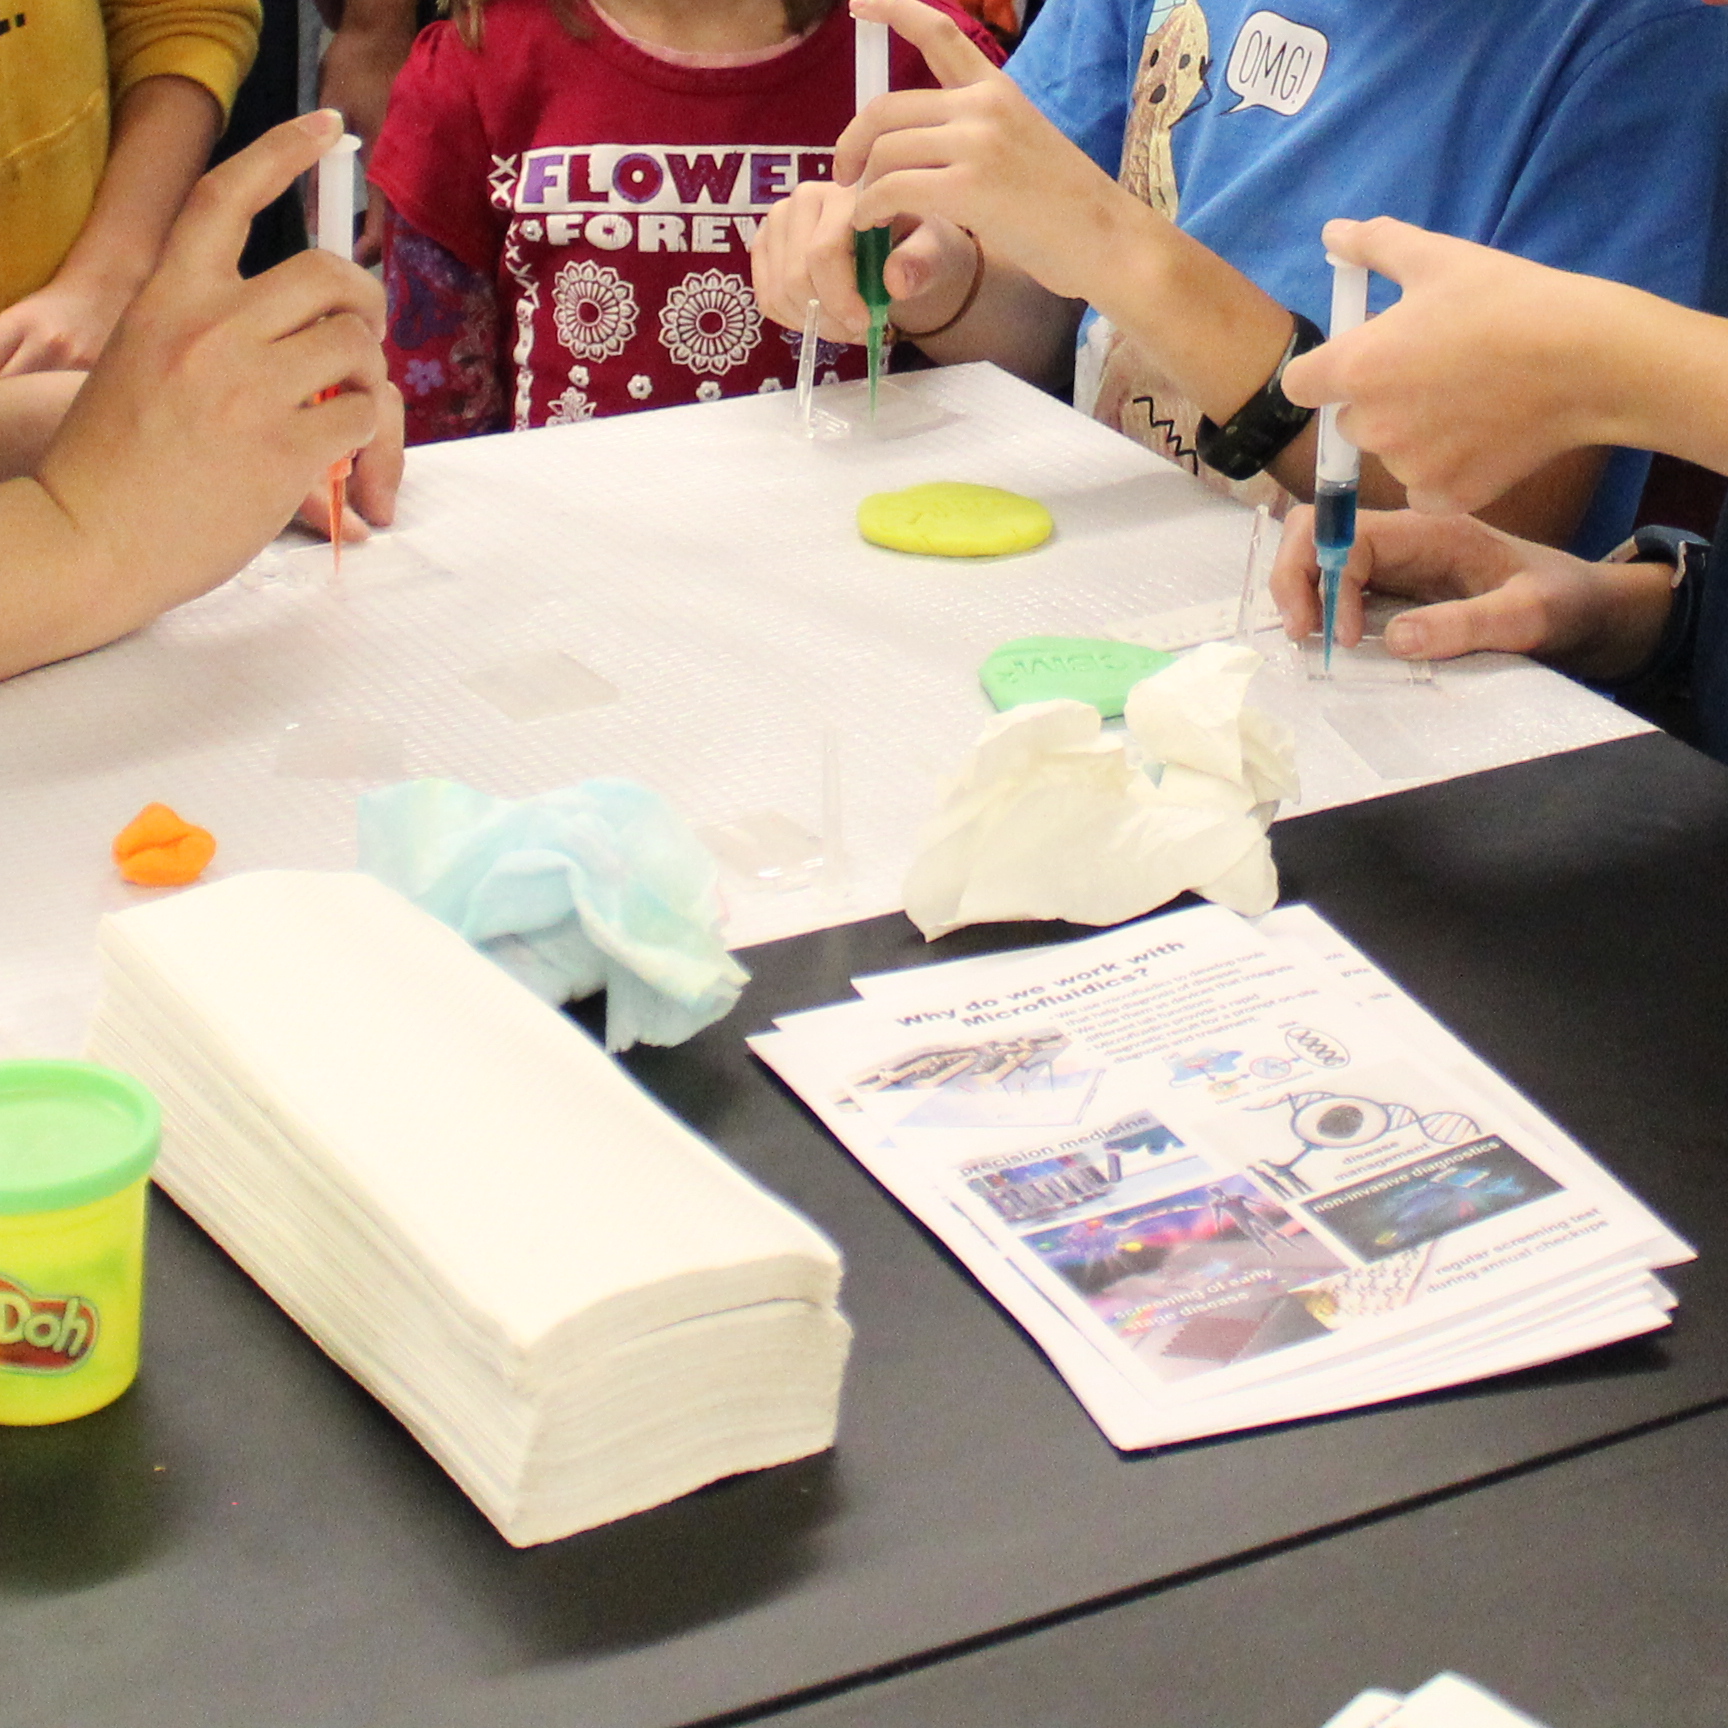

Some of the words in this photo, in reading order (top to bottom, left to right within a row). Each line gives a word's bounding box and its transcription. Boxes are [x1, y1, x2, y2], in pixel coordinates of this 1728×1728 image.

[1239, 30, 1312, 104] OMG!
[547, 214, 770, 253] FOREV
[896, 1008, 956, 1027] Why
[965, 998, 999, 1013] do
[1006, 984, 1046, 1001] we
[1053, 962, 1122, 987] work
[1126, 942, 1185, 964] with
[961, 967, 1149, 1027] Microfluidics?
[959, 1145, 1054, 1177] precision
[1058, 1116, 1150, 1150] medicine
[1334, 1142, 1430, 1181] management
[1343, 1141, 1399, 1165] disease
[1313, 1172, 1410, 1214] non-invasive
[1412, 1141, 1501, 1177] diagnostics
[1427, 1269, 1479, 1294] during
[1481, 1249, 1532, 1274] annual
[1535, 1220, 1609, 1253] checkups
[1436, 1249, 1489, 1275] regular
[1493, 1220, 1571, 1253] screening
[1571, 1208, 1601, 1223] test
[1114, 1289, 1206, 1320] screening
[1206, 1280, 1226, 1294] of
[1229, 1269, 1272, 1286] early
[1124, 1312, 1176, 1331] stage
[1180, 1291, 1250, 1317] disease
